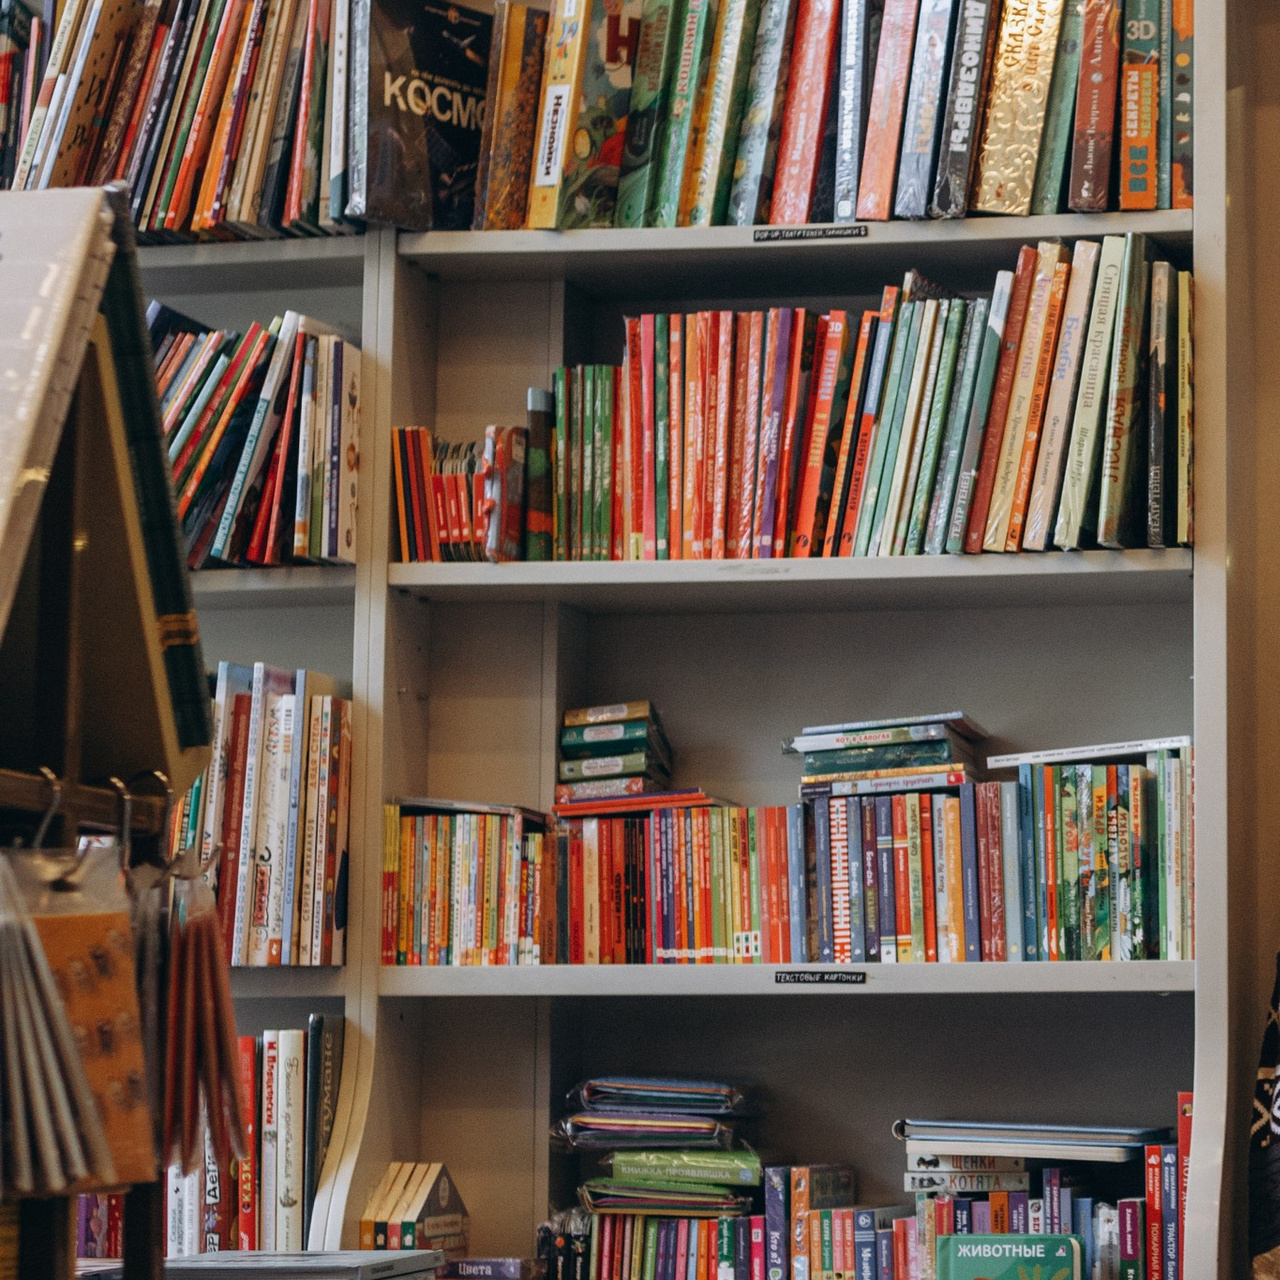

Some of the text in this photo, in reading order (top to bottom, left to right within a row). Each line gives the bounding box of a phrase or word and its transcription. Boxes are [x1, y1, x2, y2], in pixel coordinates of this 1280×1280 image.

[1126, 20, 1154, 40] 3D
[676, 11, 699, 94] КОШКИН
[1126, 69, 1139, 136] СЕКРЕТЫ
[1055, 316, 1080, 381] Бемби
[1083, 263, 1117, 409] Спящая красавица
[950, 470, 971, 539] ТЕАТР ТЕНЕЙ
[1151, 464, 1162, 534] ТЕАТР ТЕНЕЙ
[620, 1164, 730, 1179] КНИЖКА ПРОЯВЛЯШКА
[949, 1174, 1002, 1190] КОТЯТА
[951, 1156, 996, 1169] ЩЕНКИ
[957, 1244, 1044, 1258] ЖИВОТНЫЕ
[1150, 1222, 1159, 1269] ПОЖАРНАЯ
[1166, 1222, 1175, 1258] ТРАКТОР
[458, 1262, 491, 1276] Цвета
